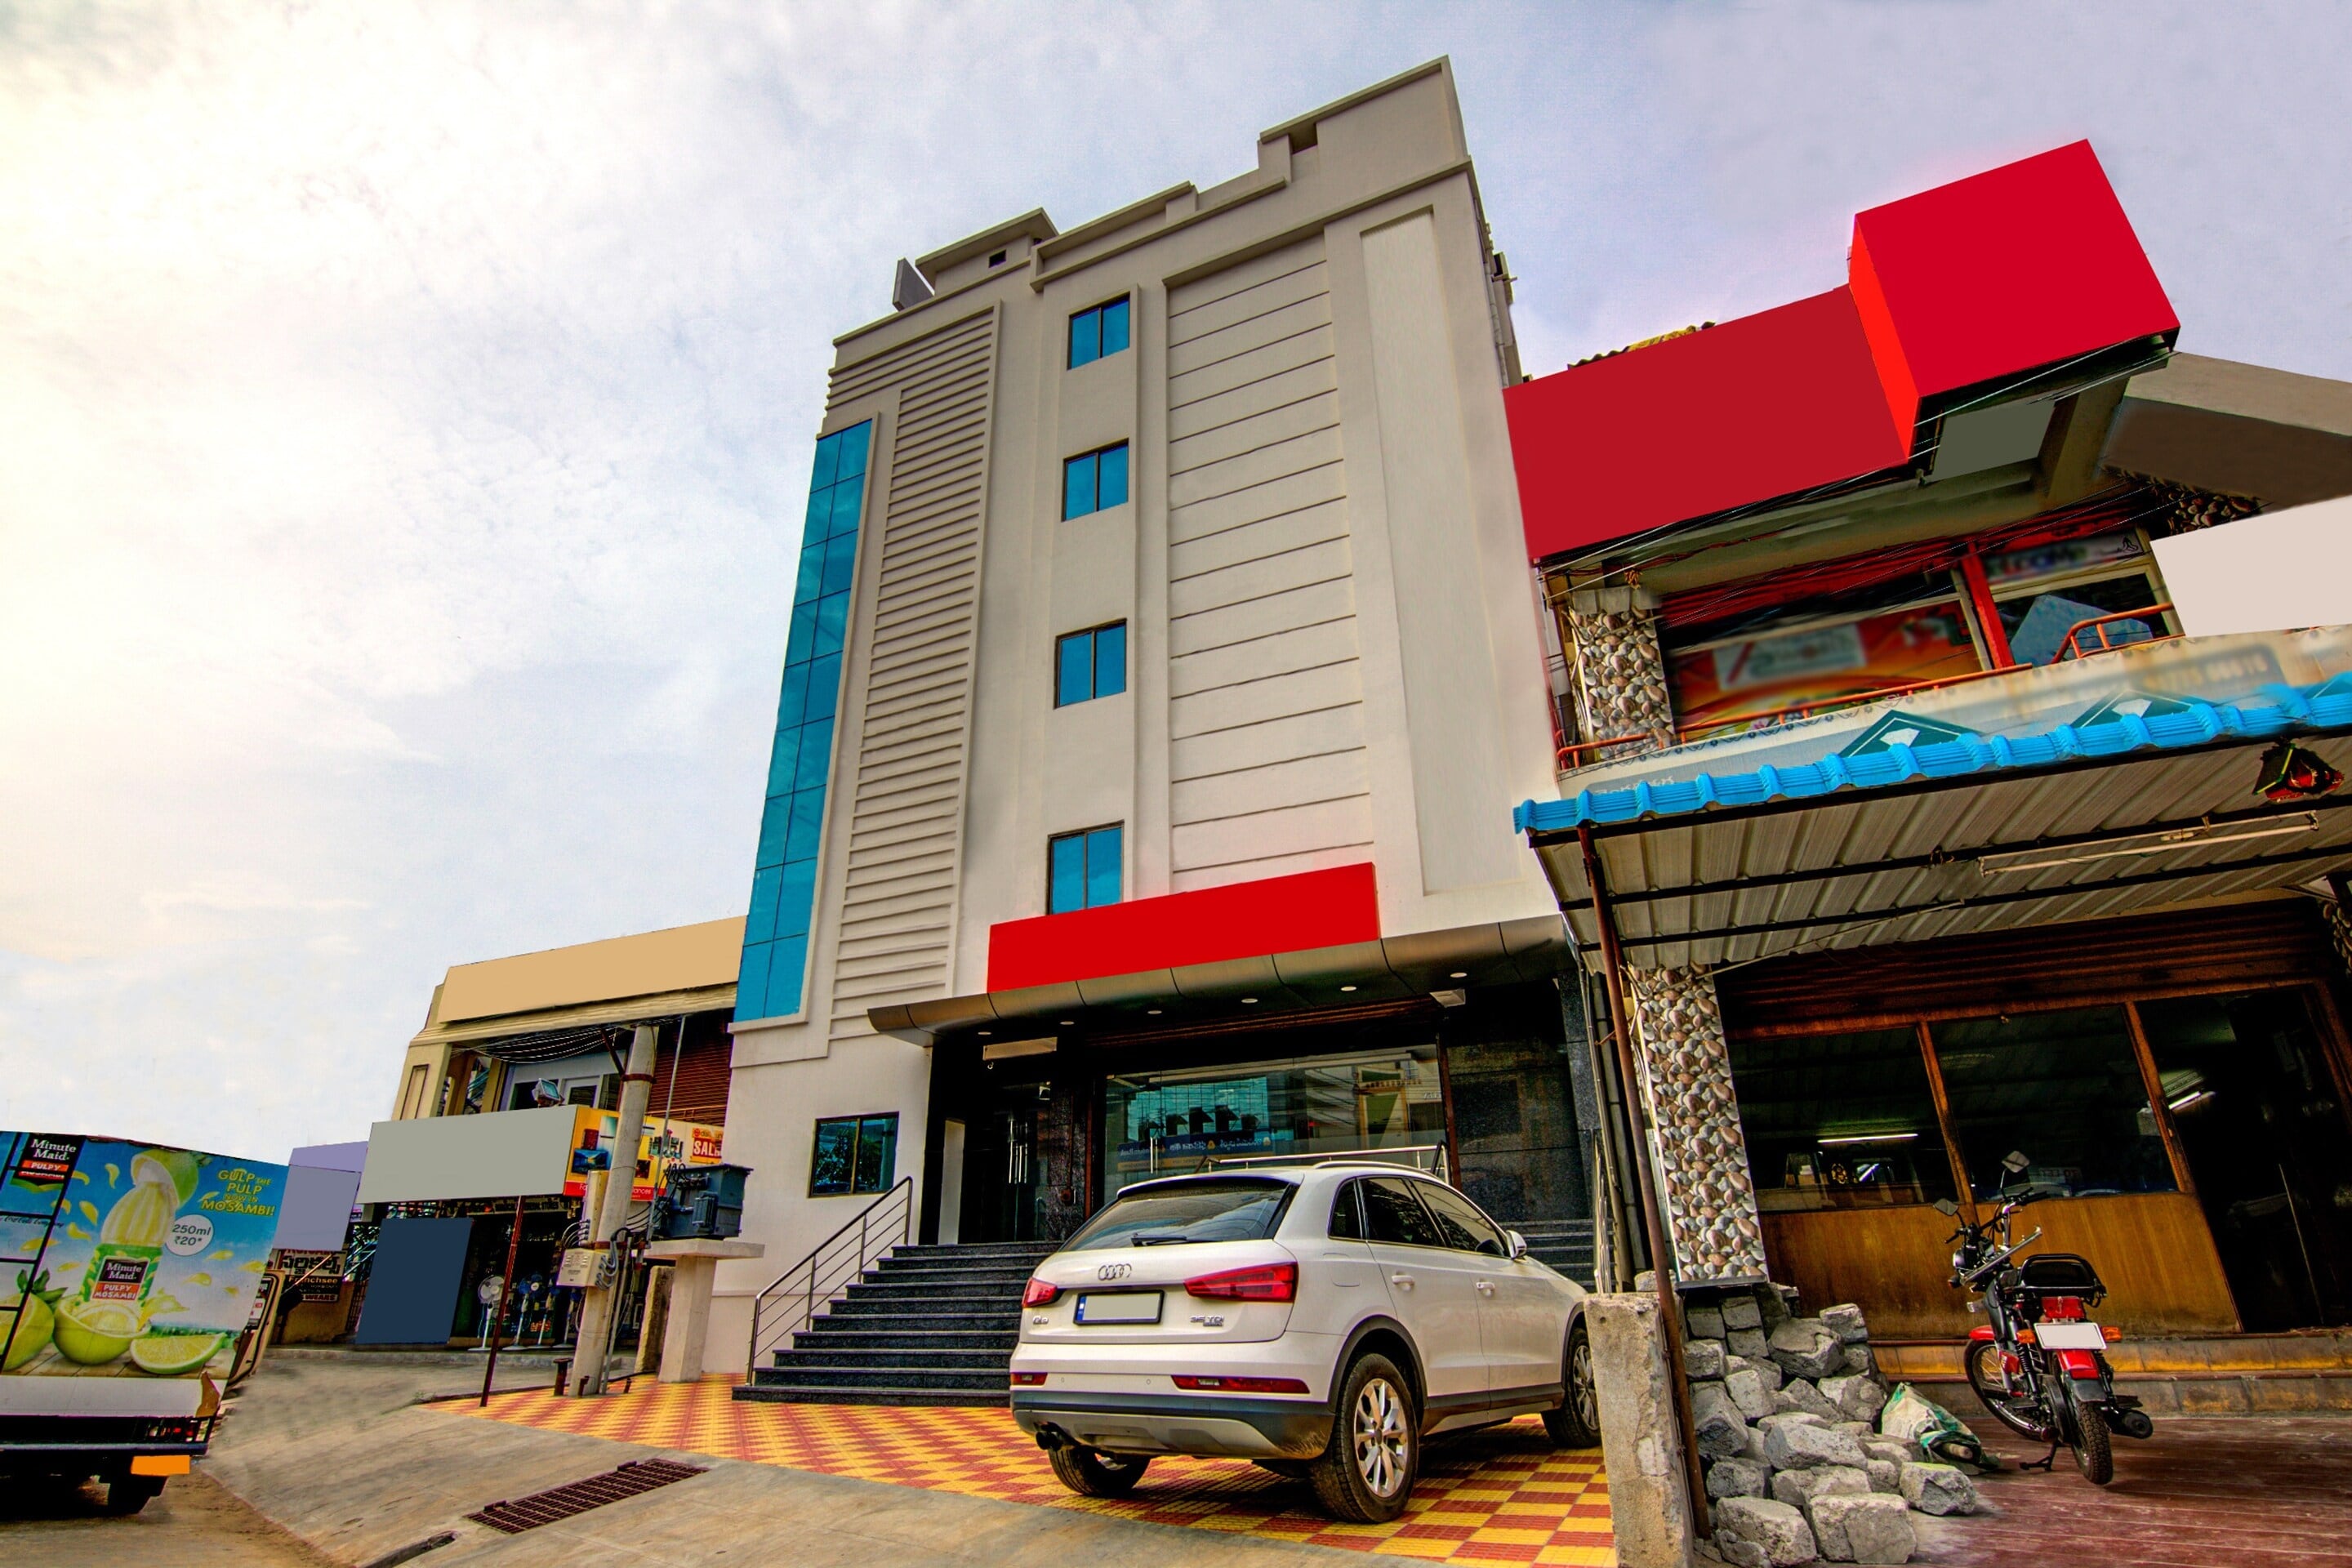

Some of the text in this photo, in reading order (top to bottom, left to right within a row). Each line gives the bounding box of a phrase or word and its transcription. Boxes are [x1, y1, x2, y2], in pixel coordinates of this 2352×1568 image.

[31, 1138, 77, 1152] Minute
[31, 1162, 61, 1170] PULPY
[218, 1169, 256, 1182] GULP
[227, 1183, 262, 1194] PULP
[202, 1199, 275, 1216] MOSAMBI!
[172, 1224, 212, 1236] 250ml
[107, 1262, 142, 1272] Minute
[104, 1284, 131, 1292] PULPY
[94, 1291, 136, 1299] MOSAMBI
